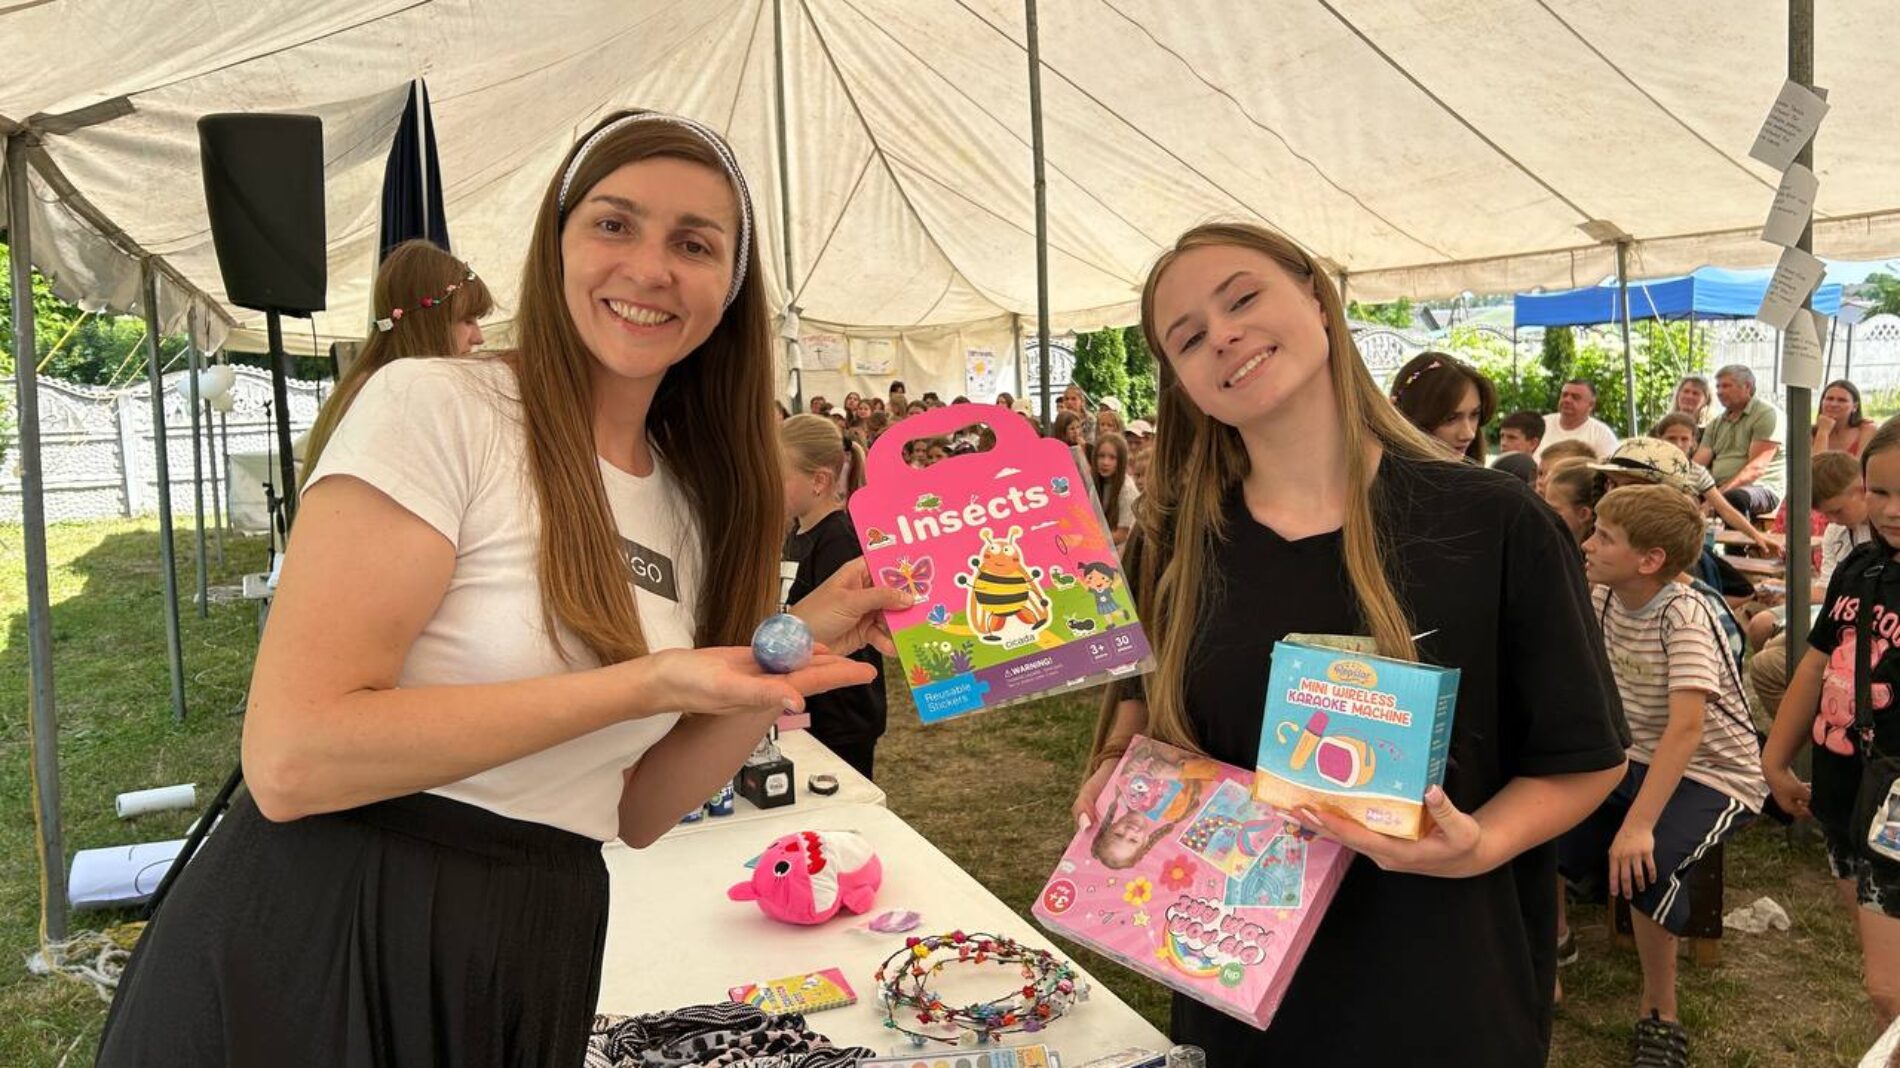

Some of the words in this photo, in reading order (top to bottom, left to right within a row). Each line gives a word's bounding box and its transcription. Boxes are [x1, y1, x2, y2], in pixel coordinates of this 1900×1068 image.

[897, 485, 1049, 545] Insects
[625, 552, 662, 583] GO
[1091, 642, 1105, 655] 3+
[1114, 634, 1130, 647] 30
[1011, 656, 1053, 675] WARNING!
[924, 682, 971, 703] Reusable
[928, 694, 969, 712] Stickers
[1301, 679, 1328, 695] MINI
[1332, 685, 1395, 708] WIRELESS
[1288, 690, 1348, 712] KARAOKE
[1351, 702, 1411, 725] MACHINE
